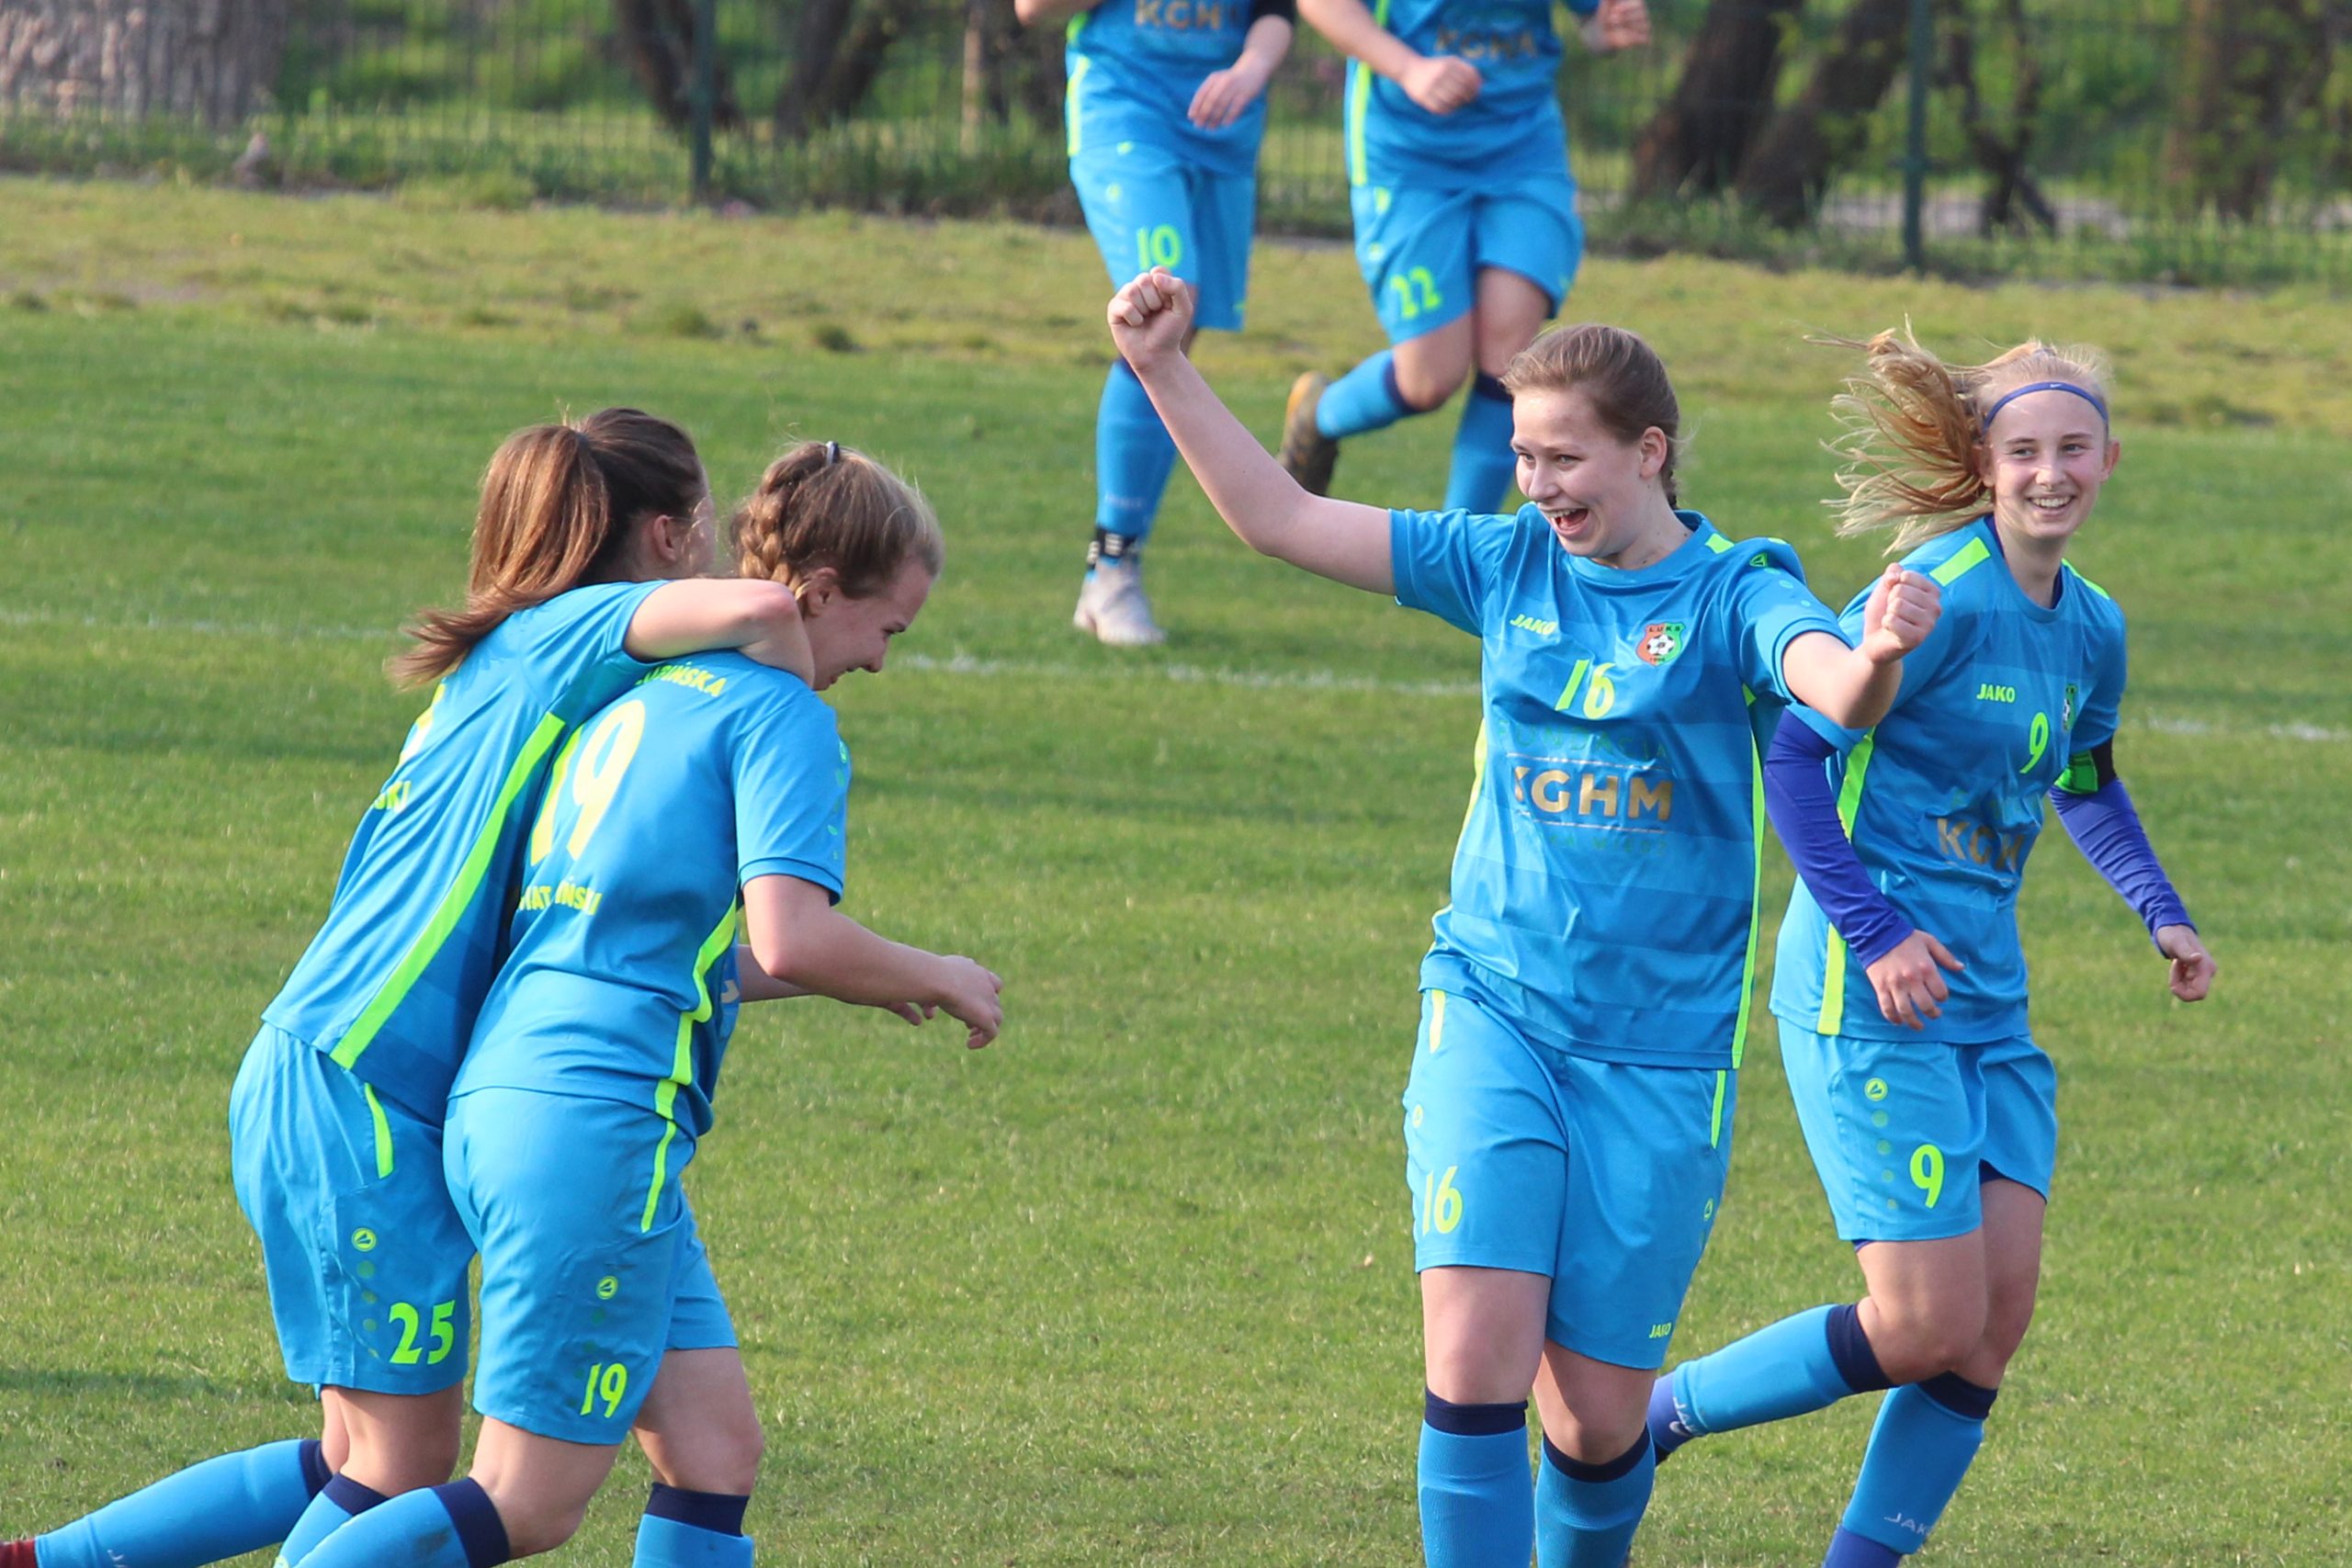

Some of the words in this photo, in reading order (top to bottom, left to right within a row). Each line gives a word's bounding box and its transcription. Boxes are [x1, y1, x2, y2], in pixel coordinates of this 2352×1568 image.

[1136, 224, 1182, 272] 10
[1390, 264, 1441, 321] 22
[1510, 614, 1557, 635] JAKO
[1555, 659, 1617, 720] 16
[1976, 683, 2016, 703] JAKO
[2019, 711, 2050, 773] 9
[530, 699, 646, 867] 19
[1422, 1165, 1463, 1237] 16
[1910, 1144, 1945, 1209] 9
[389, 1300, 456, 1365] 25
[580, 1363, 628, 1418] 19
